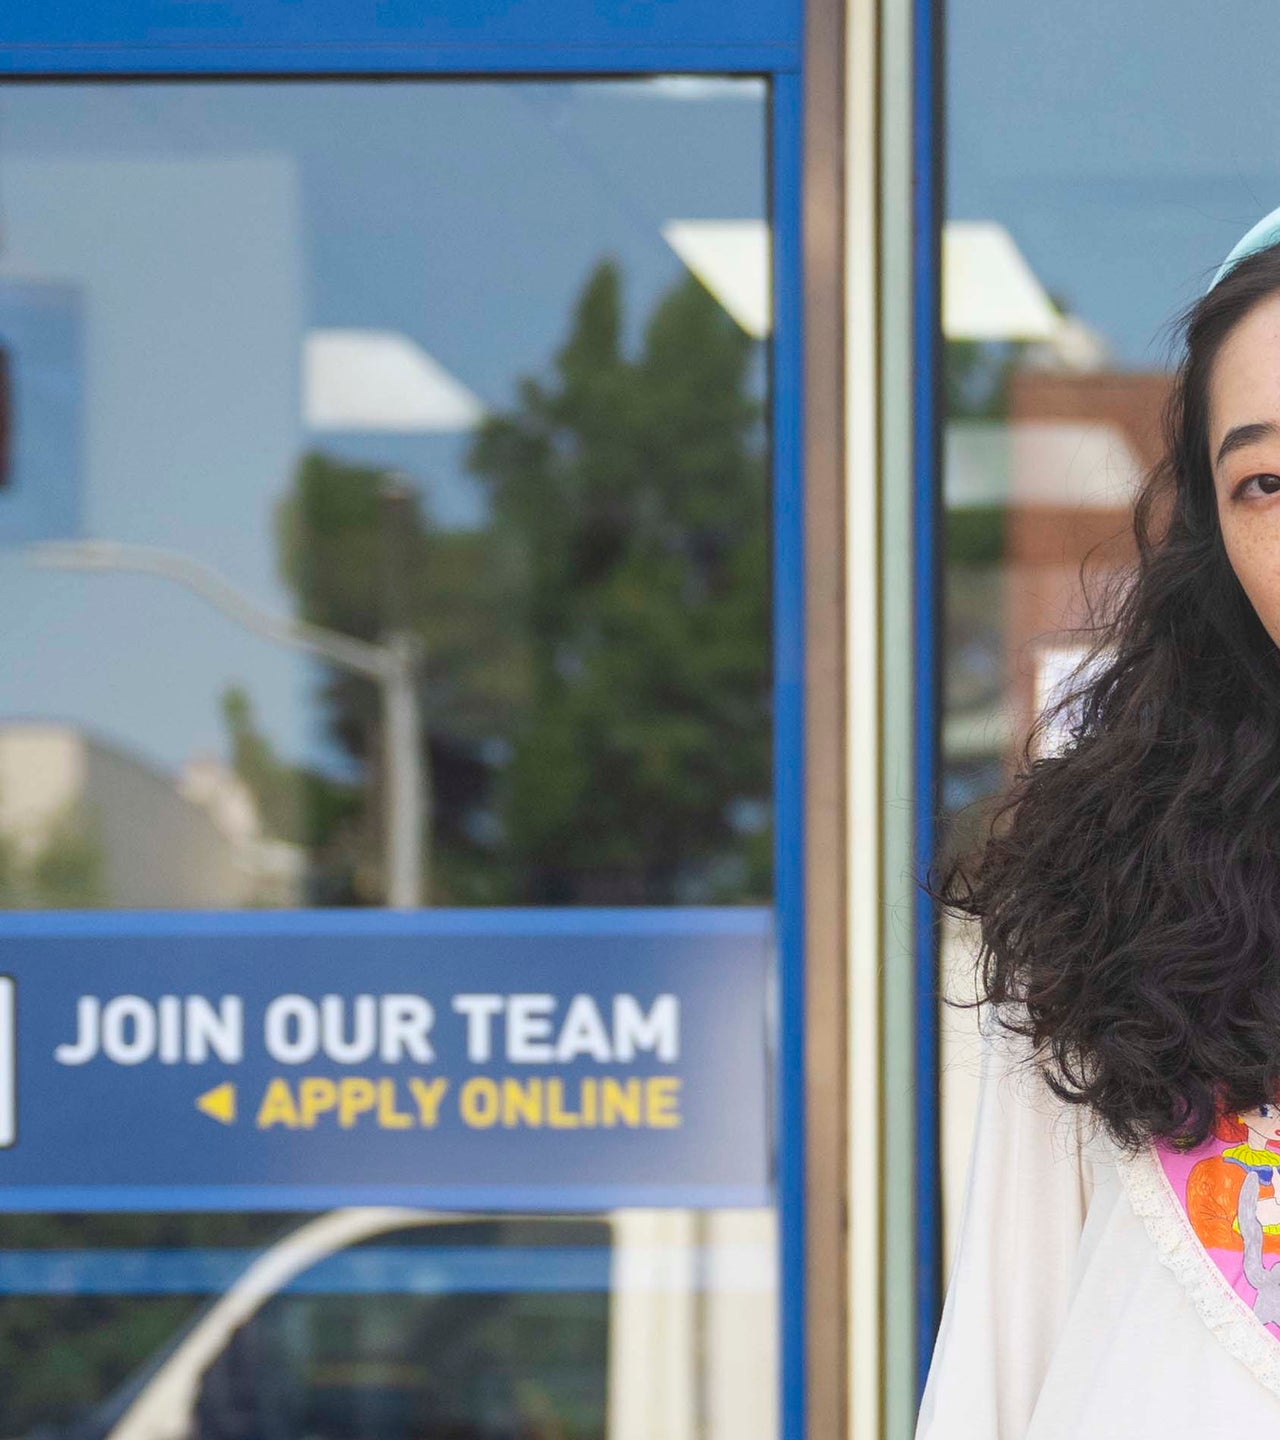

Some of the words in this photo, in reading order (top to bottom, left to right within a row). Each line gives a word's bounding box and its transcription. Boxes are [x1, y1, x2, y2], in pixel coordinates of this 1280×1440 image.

[54, 994, 243, 1065] JOIN
[263, 993, 437, 1065] OUR
[450, 992, 680, 1064] TEAM
[256, 1076, 448, 1130] APPLY
[459, 1075, 683, 1129] ONLINE
